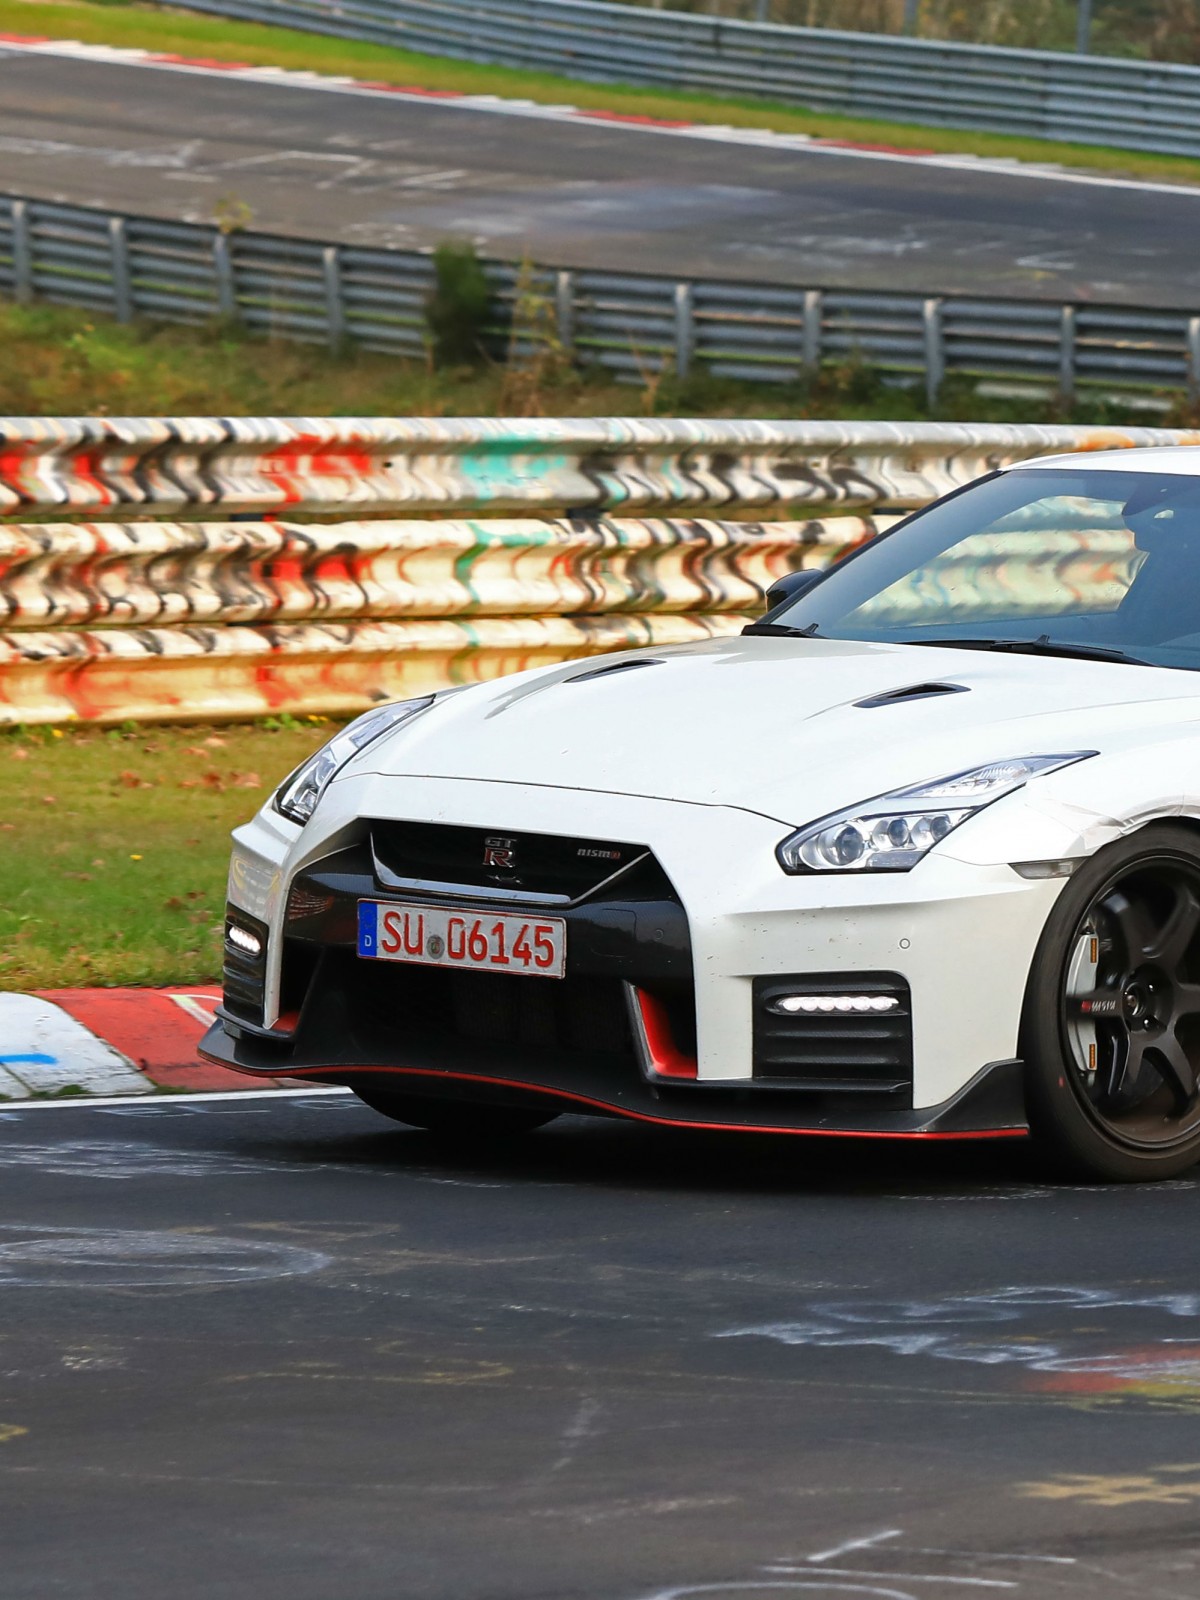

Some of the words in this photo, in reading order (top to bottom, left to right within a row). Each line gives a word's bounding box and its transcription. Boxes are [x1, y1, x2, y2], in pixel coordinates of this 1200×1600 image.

[484, 837, 517, 848] GT
[482, 847, 516, 868] R
[364, 934, 372, 948] D
[381, 911, 424, 956] SU
[447, 917, 555, 968] 06145
